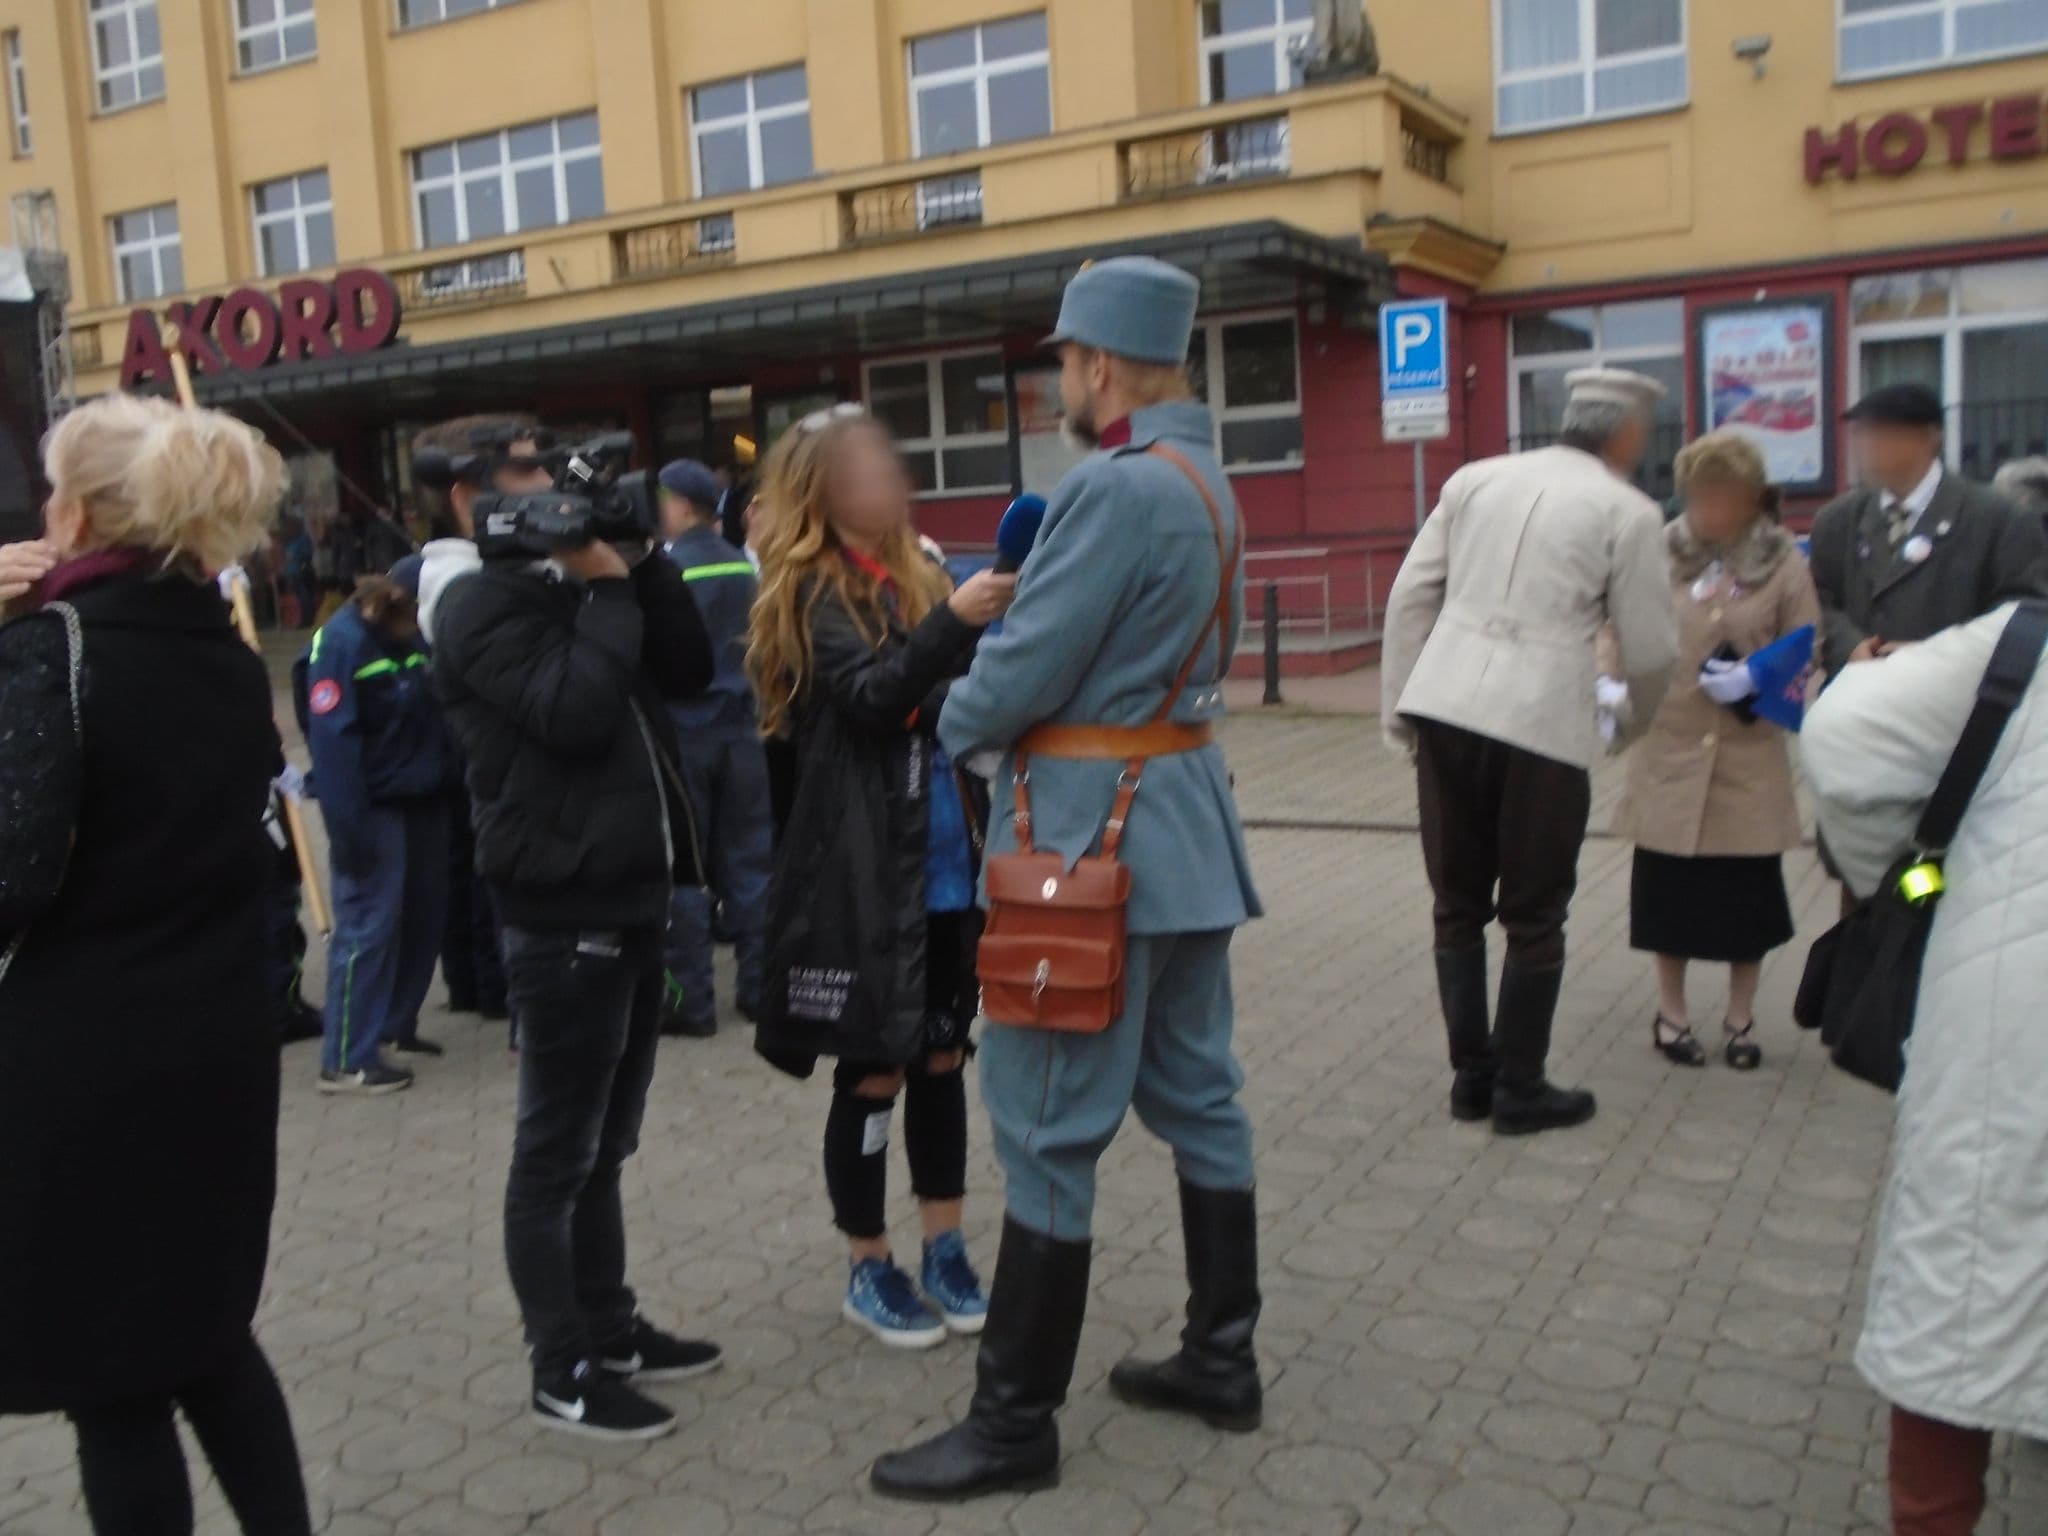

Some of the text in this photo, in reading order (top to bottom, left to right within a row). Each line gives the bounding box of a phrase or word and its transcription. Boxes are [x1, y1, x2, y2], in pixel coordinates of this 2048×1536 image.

[1804, 90, 2048, 186] HOTE
[119, 267, 400, 392] AKORD
[1394, 312, 1432, 369] P
